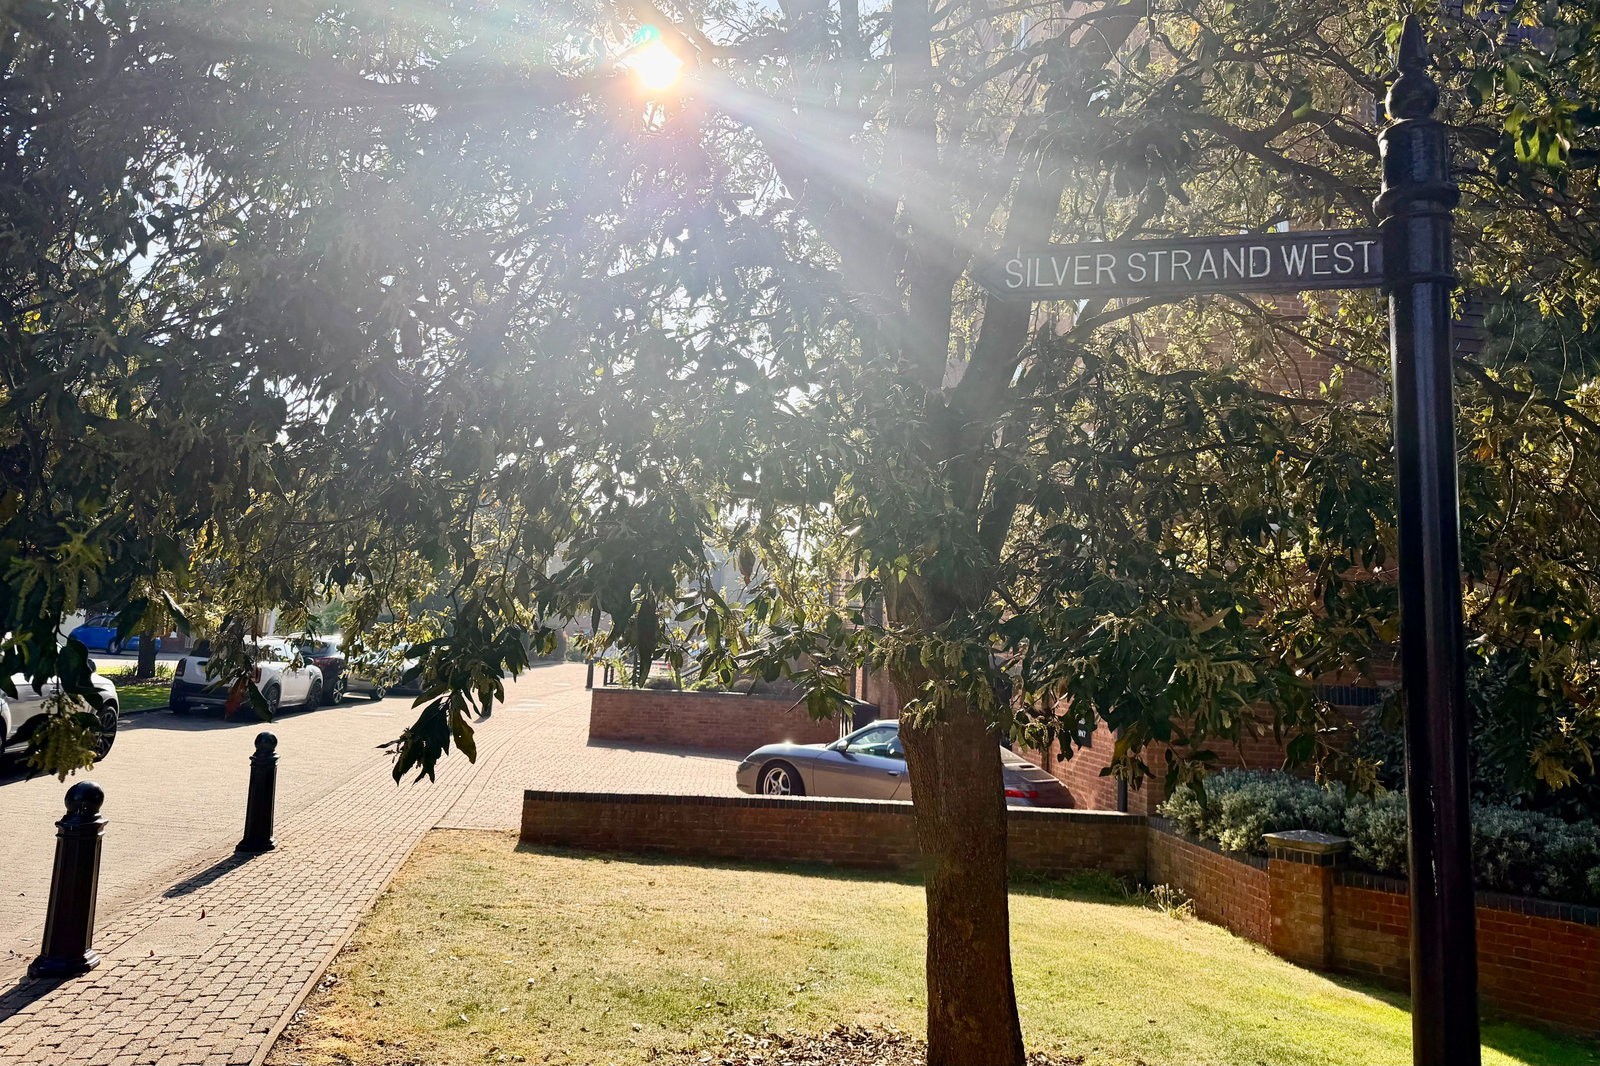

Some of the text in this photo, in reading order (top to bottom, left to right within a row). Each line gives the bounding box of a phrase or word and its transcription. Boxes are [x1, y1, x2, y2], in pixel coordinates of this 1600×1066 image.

[1005, 240, 1376, 288] SILVER STRAND WEST
